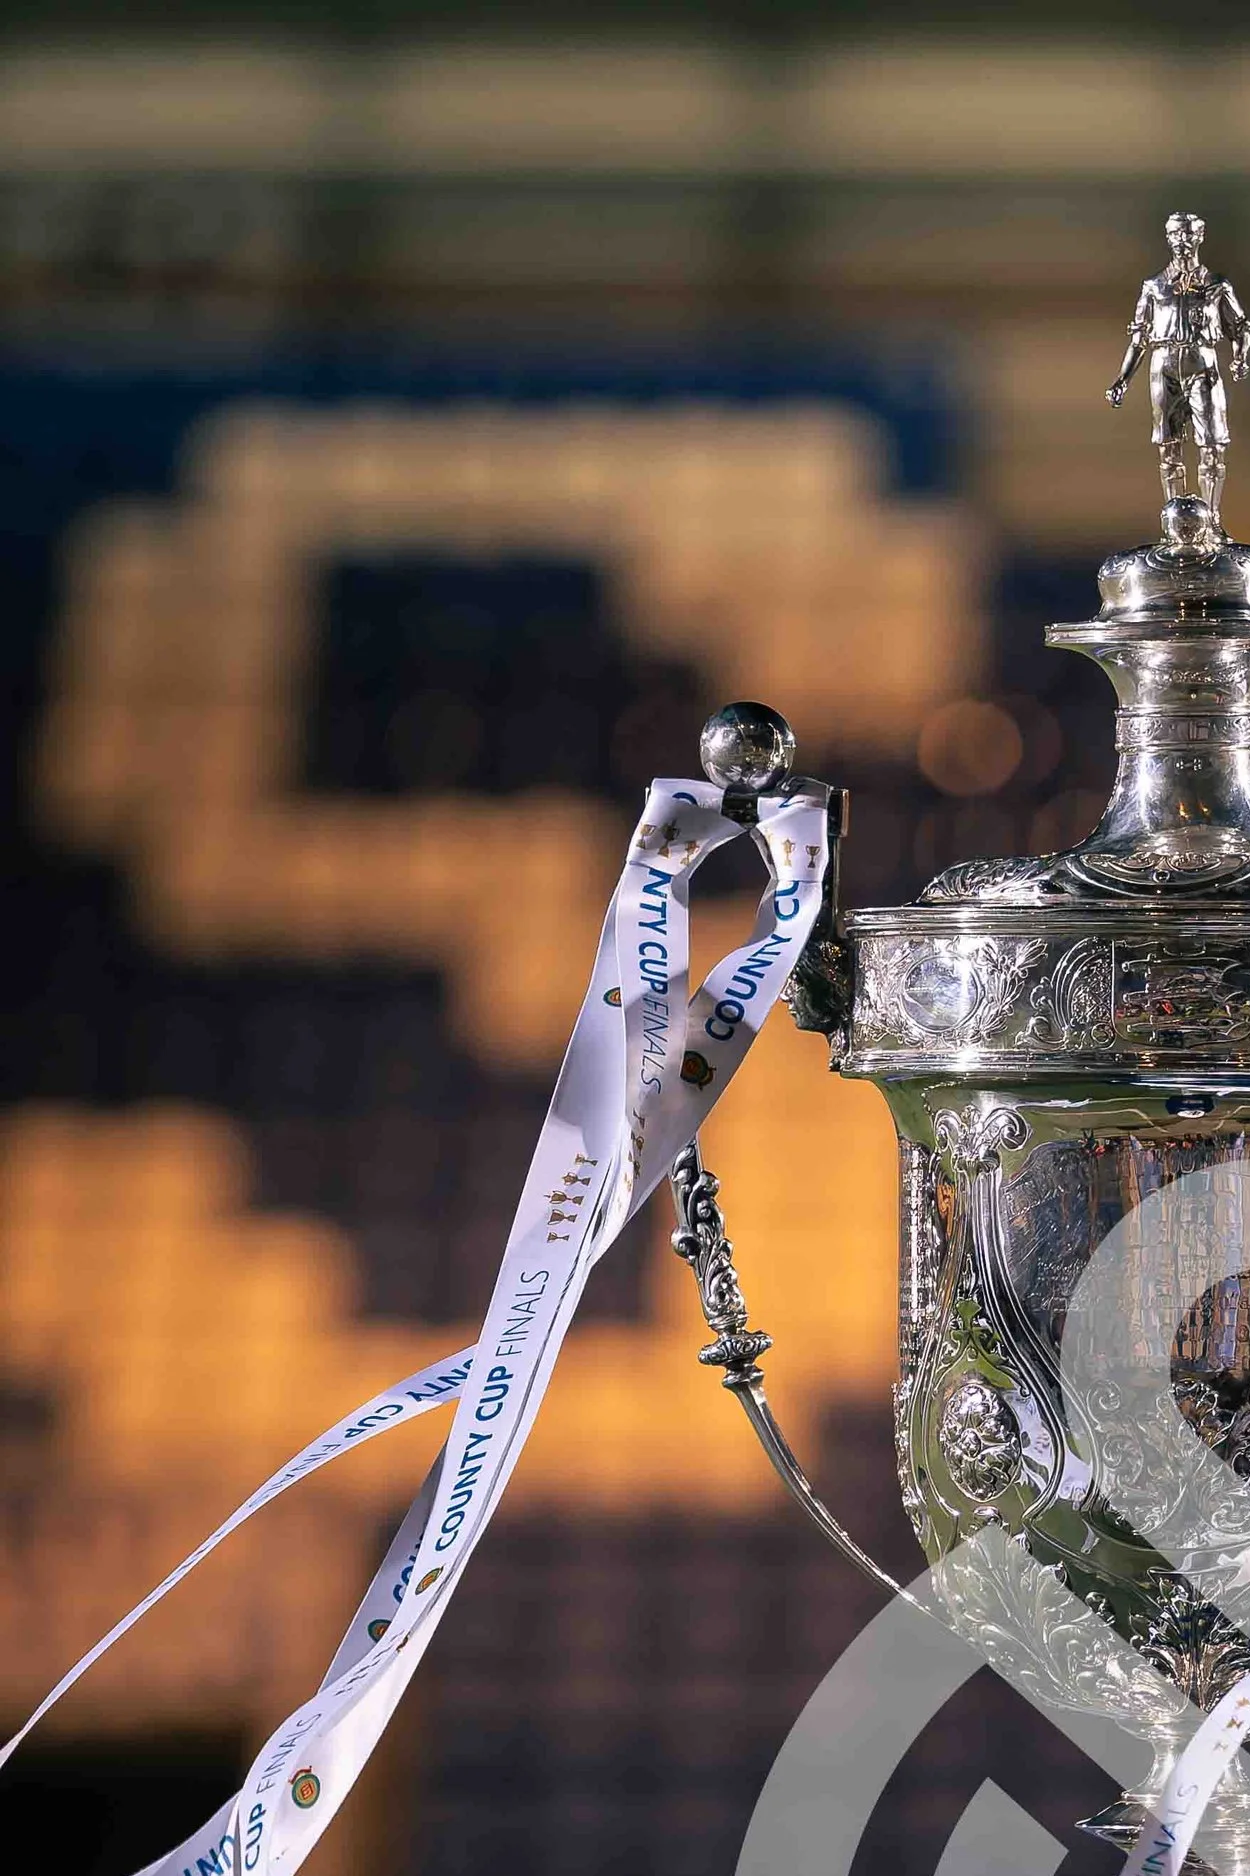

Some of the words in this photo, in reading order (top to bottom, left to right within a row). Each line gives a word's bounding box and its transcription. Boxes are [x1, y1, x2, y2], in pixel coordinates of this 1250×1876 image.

[637, 867, 672, 936] NTY
[638, 940, 669, 998] CUP
[704, 933, 792, 1042] COUNTY
[772, 879, 801, 921] CU
[638, 996, 671, 1094] FINALS
[344, 1403, 404, 1439] CUP
[405, 1358, 475, 1402] NTY
[434, 1430, 494, 1552] COUNTY
[475, 1365, 514, 1421] CUP
[495, 1269, 550, 1357] FINALS
[244, 1803, 267, 1871] CUP
[256, 1712, 322, 1794] FINALS
